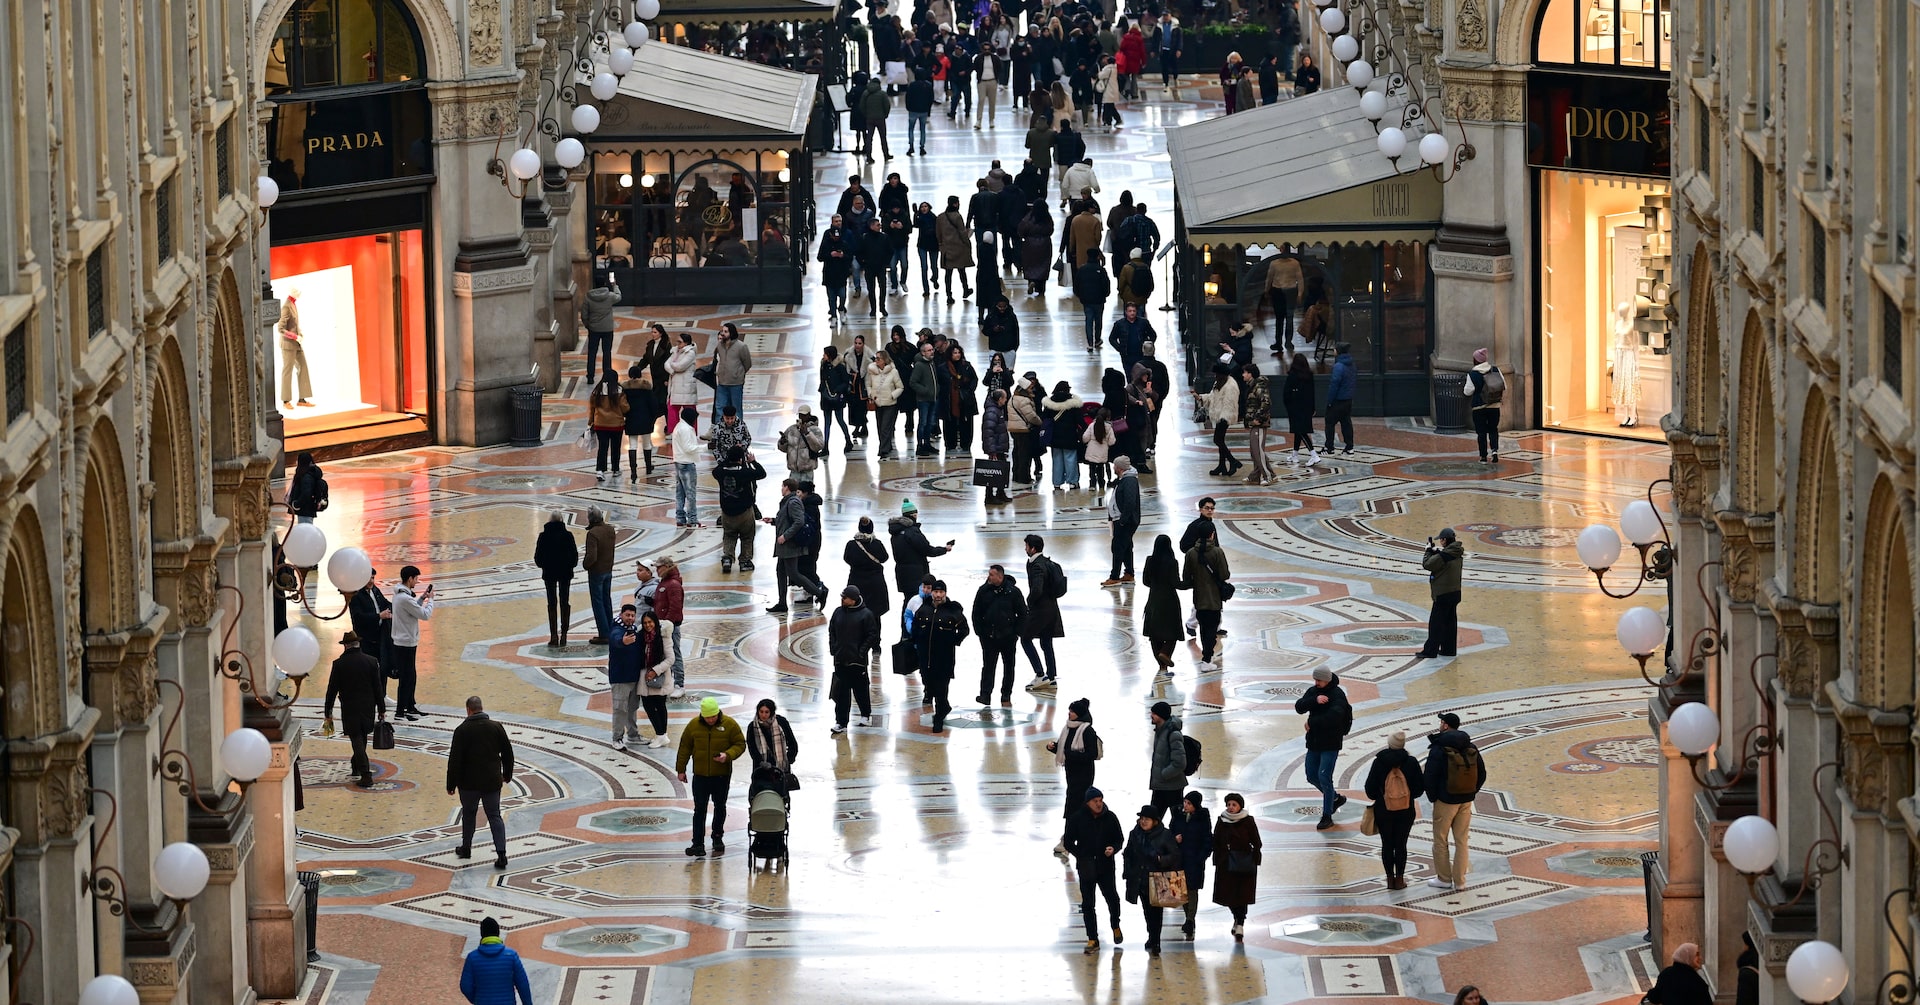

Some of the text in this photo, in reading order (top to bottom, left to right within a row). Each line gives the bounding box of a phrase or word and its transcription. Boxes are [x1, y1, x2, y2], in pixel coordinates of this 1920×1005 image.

[1568, 106, 1653, 144] DIOR
[307, 131, 384, 154] PRADA
[1373, 183, 1409, 217] CRACCO
